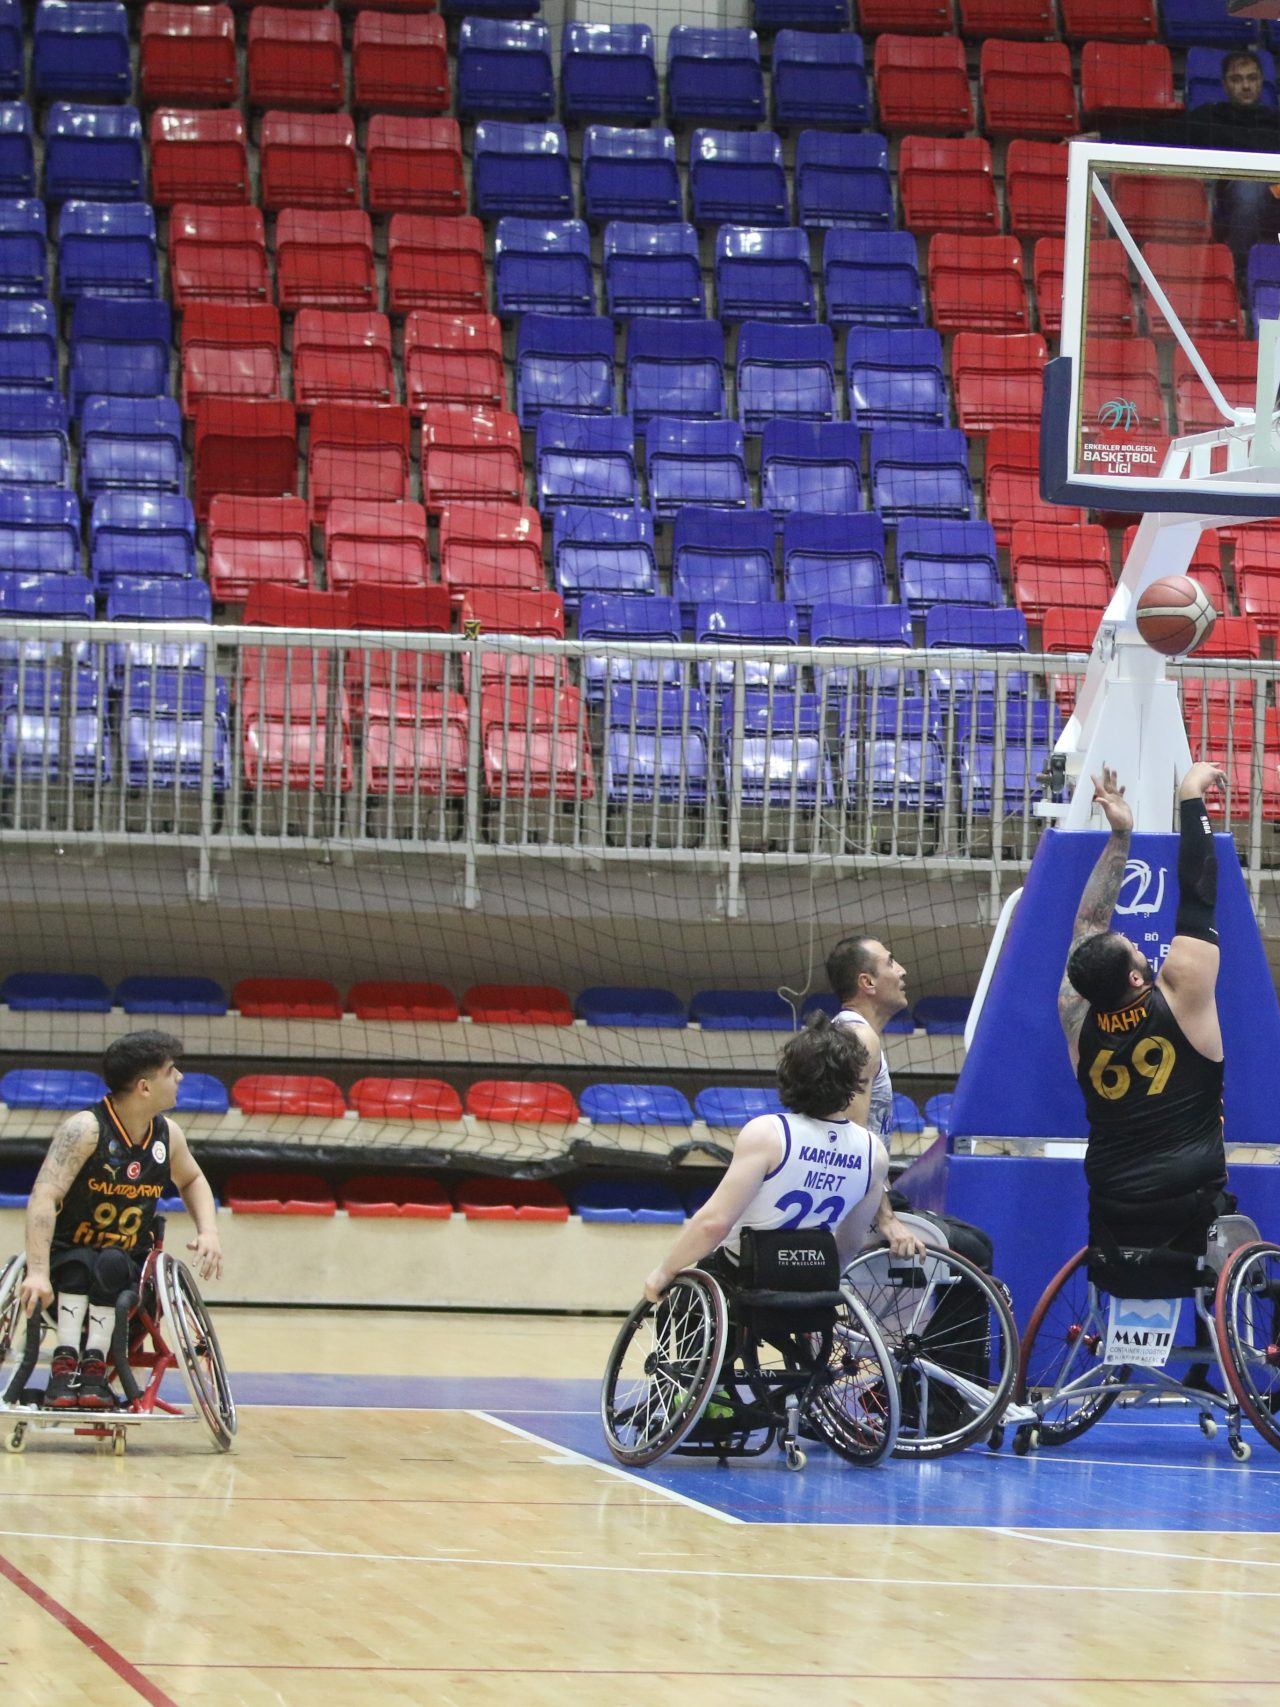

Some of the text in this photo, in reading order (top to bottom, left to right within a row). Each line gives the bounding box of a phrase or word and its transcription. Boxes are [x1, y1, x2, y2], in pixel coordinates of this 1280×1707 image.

[1084, 443, 1120, 451] ERKEKLER
[1083, 451, 1156, 463] BASKETBOL
[1108, 461, 1131, 474] LİGİ
[1088, 1035, 1176, 1100] 69
[799, 1145, 862, 1170] KARÇİMSA
[803, 1170, 846, 1192] MERT
[778, 1249, 825, 1261] EXTRA
[1112, 1330, 1170, 1346] MARTI
